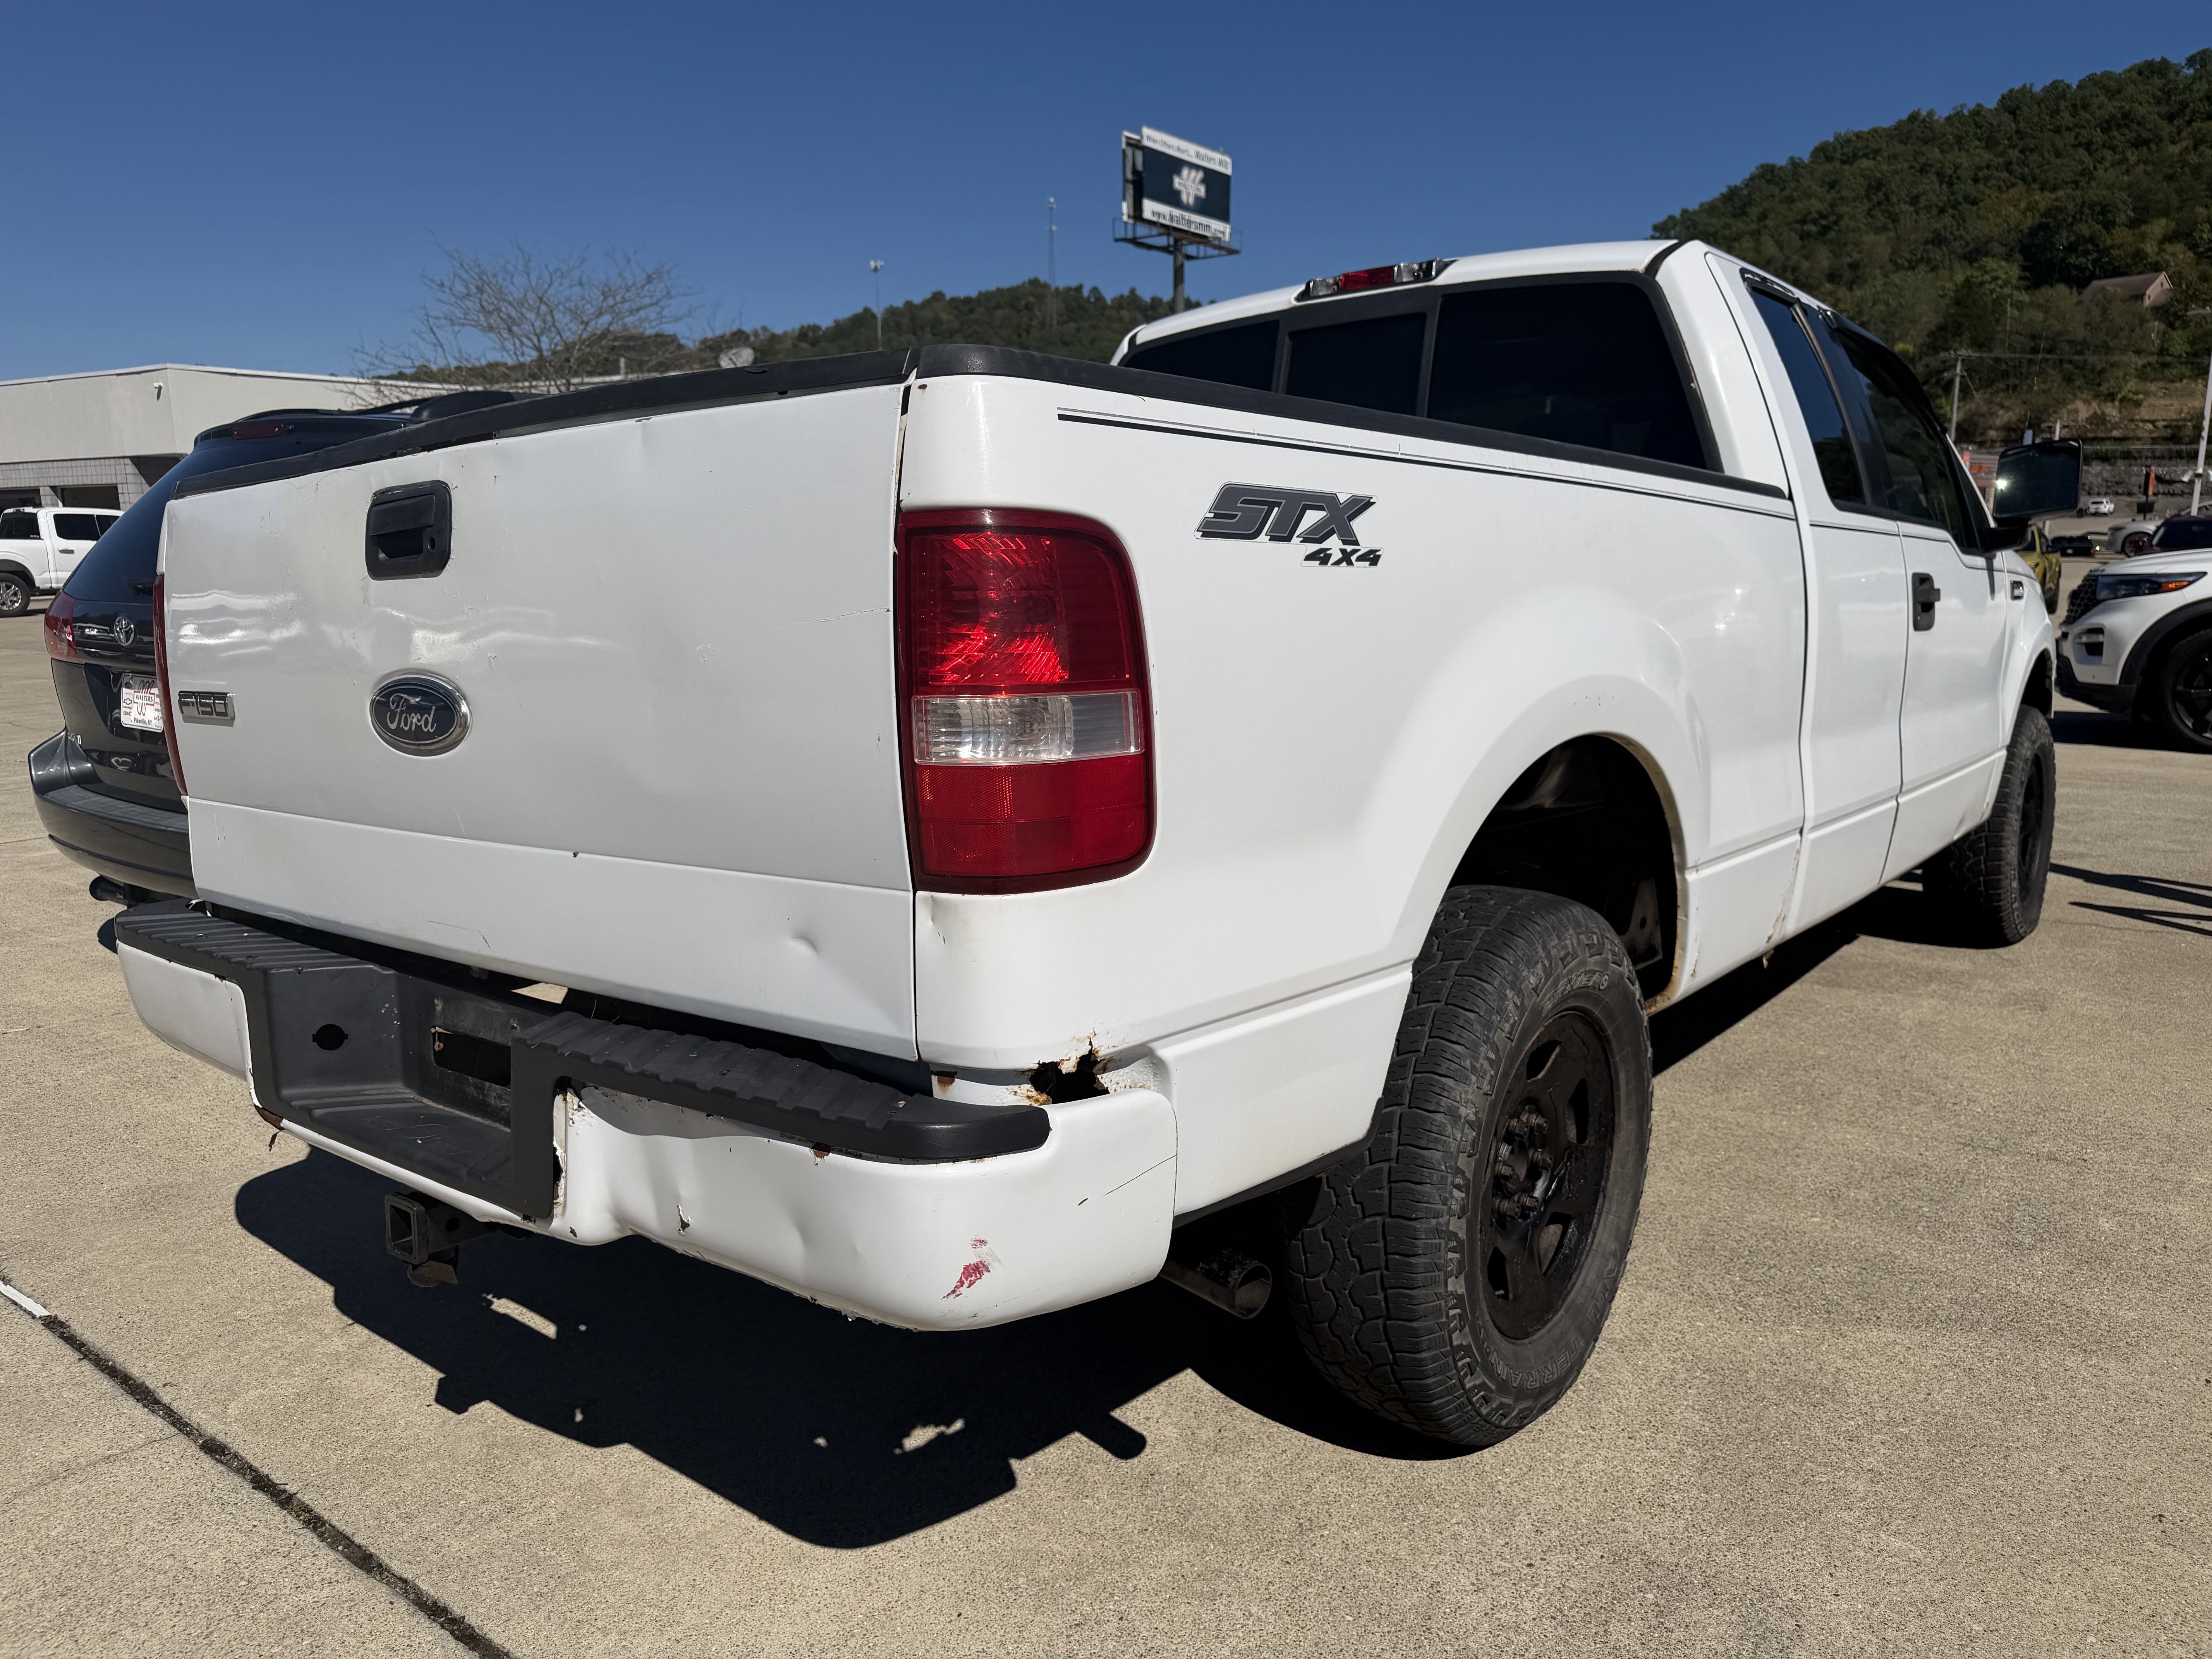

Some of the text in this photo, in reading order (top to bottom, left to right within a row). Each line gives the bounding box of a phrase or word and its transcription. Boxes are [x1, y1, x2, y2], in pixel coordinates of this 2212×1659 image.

[1196, 483, 1376, 546] STX
[136, 694, 153, 702] WALTERS
[386, 693, 436, 732] Ford
[1488, 1337, 1585, 1390] TERRAIN
